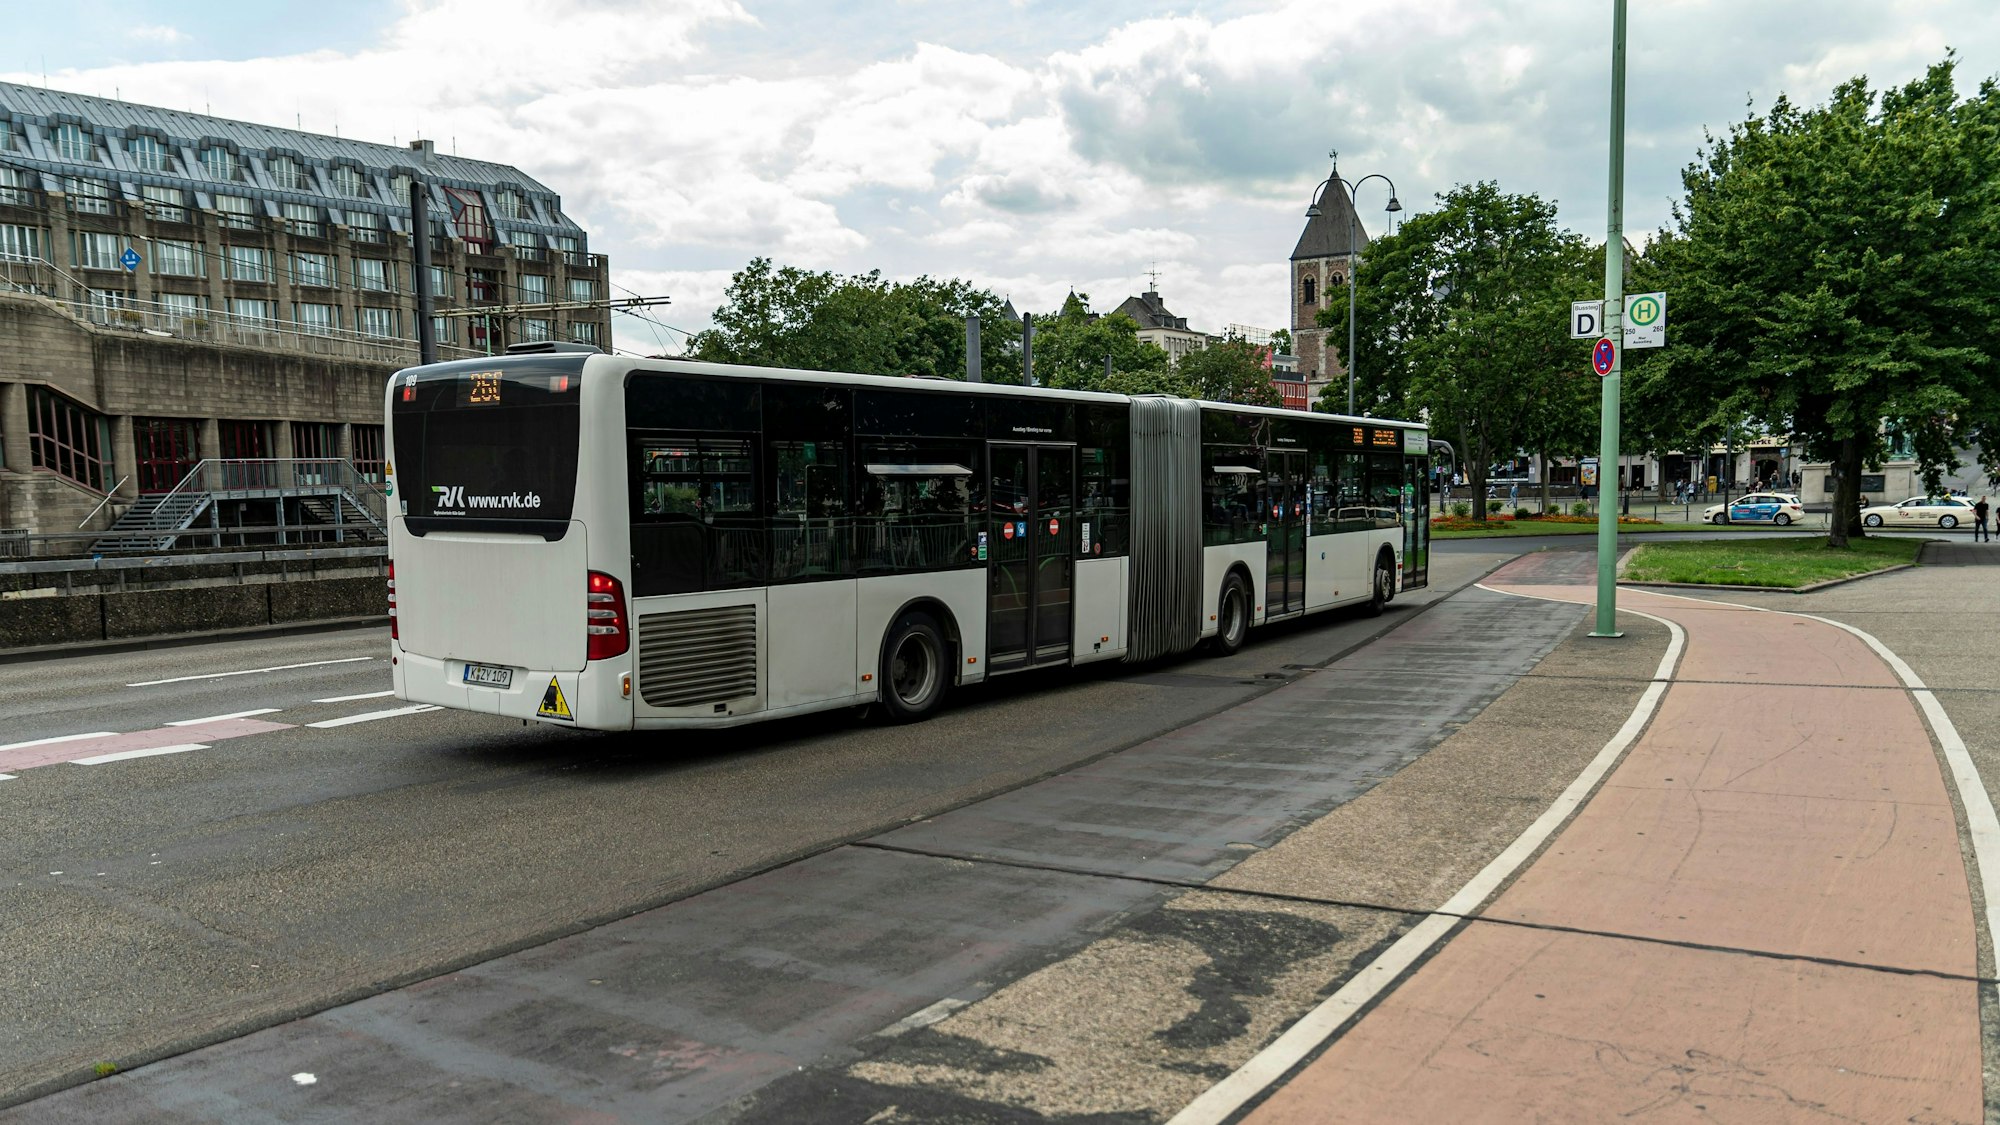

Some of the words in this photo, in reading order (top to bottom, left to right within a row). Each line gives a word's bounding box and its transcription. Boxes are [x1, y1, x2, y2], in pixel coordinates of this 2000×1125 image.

[1638, 303, 1651, 319] H
[1577, 314, 1595, 335] D
[405, 374, 418, 387] 109
[467, 491, 541, 508] www.rvk.de
[470, 667, 477, 680] K
[480, 668, 492, 681] ZY
[492, 670, 508, 683] 109
